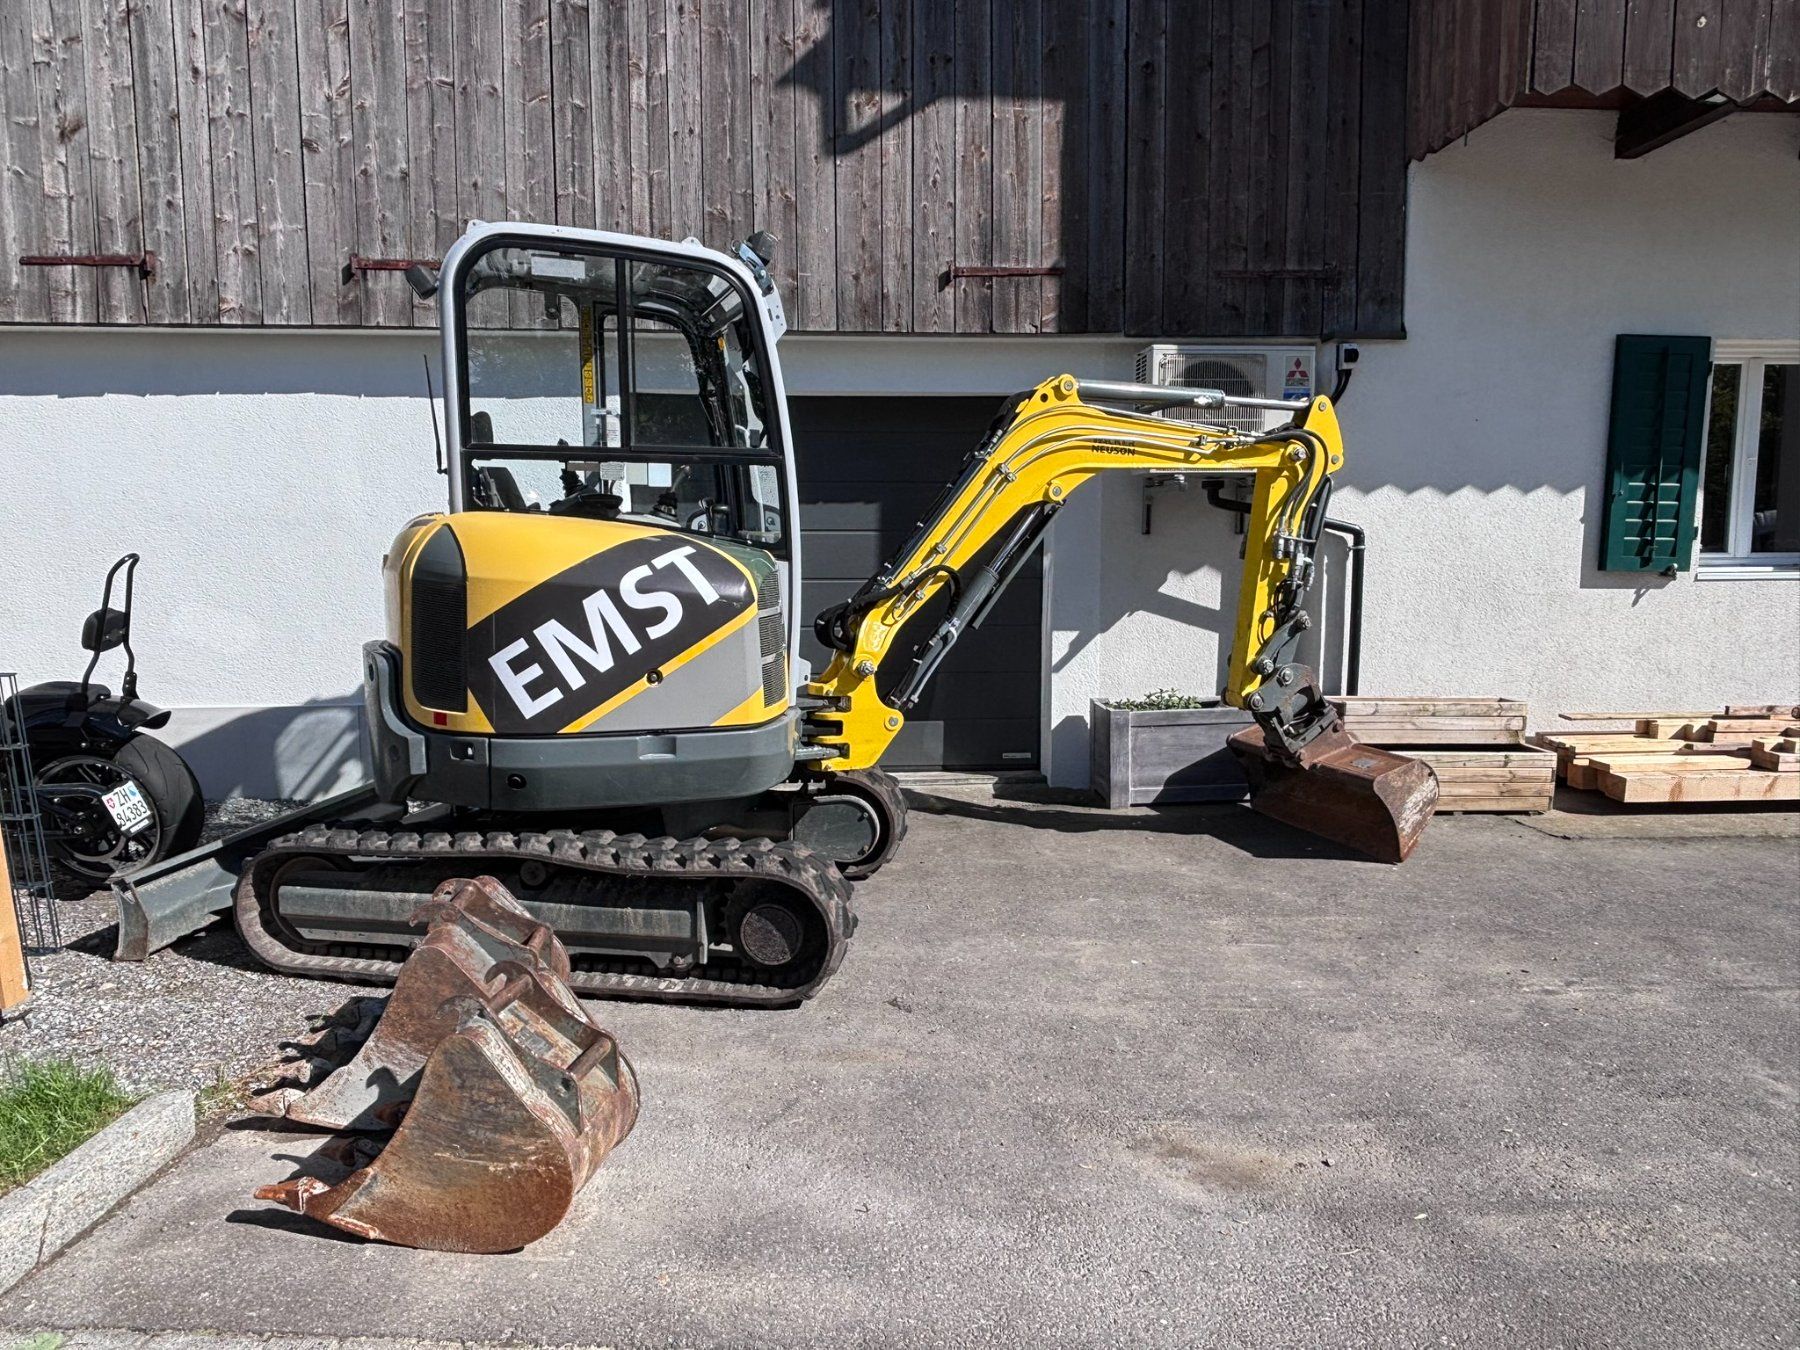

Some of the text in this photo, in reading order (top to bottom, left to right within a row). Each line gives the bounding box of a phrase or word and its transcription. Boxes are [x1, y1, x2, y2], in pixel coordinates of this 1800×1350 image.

[1091, 445, 1136, 456] NEUSON
[488, 545, 721, 720] EMST
[113, 788, 131, 807] ZH
